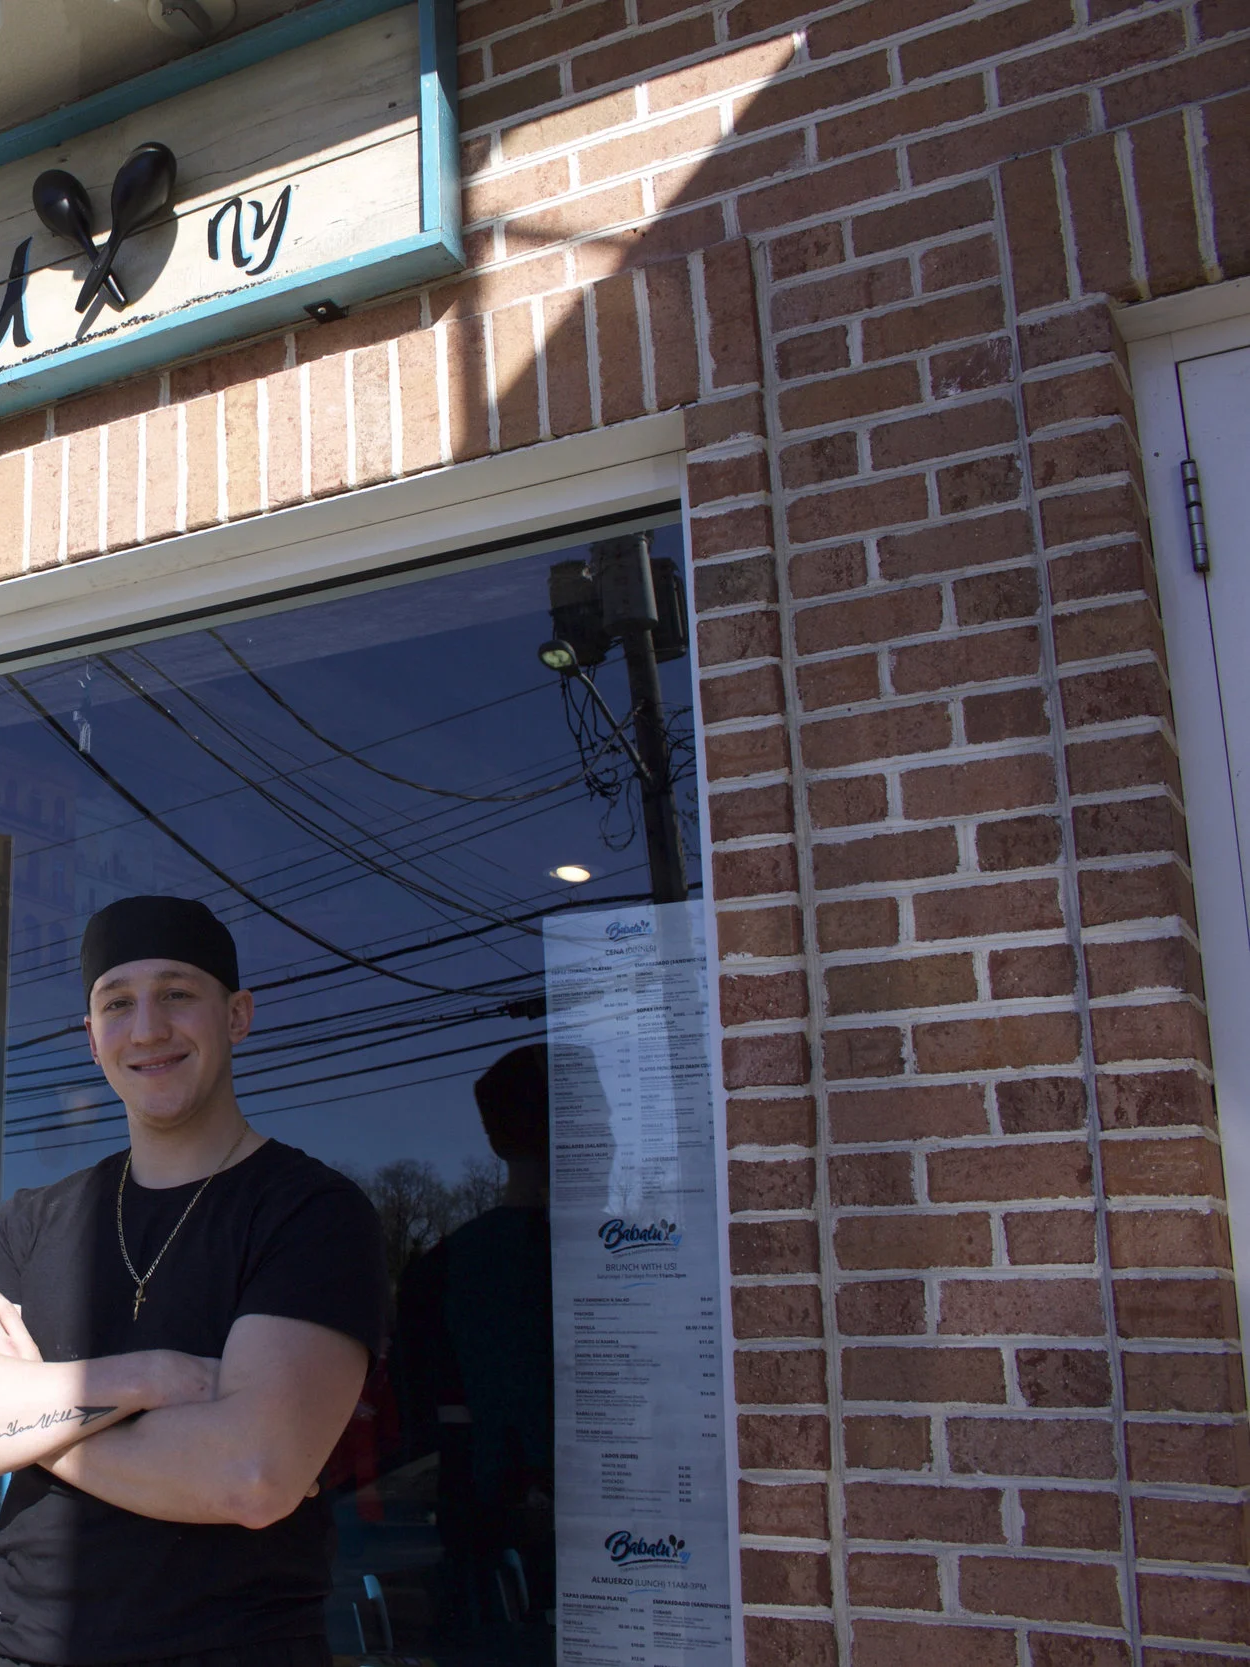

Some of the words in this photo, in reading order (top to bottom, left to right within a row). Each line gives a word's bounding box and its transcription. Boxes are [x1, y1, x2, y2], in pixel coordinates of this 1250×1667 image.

[207, 184, 297, 276] ny
[598, 1219, 662, 1249] Babalu
[606, 1263, 639, 1271] BRUNCH
[641, 1263, 662, 1271] WITH
[664, 1262, 678, 1271] US!
[604, 1530, 671, 1562] Babalu
[591, 1576, 634, 1586] ALMUERZO
[635, 1578, 666, 1589] (LUNCH)
[652, 1599, 690, 1607] EMPAREDADO
